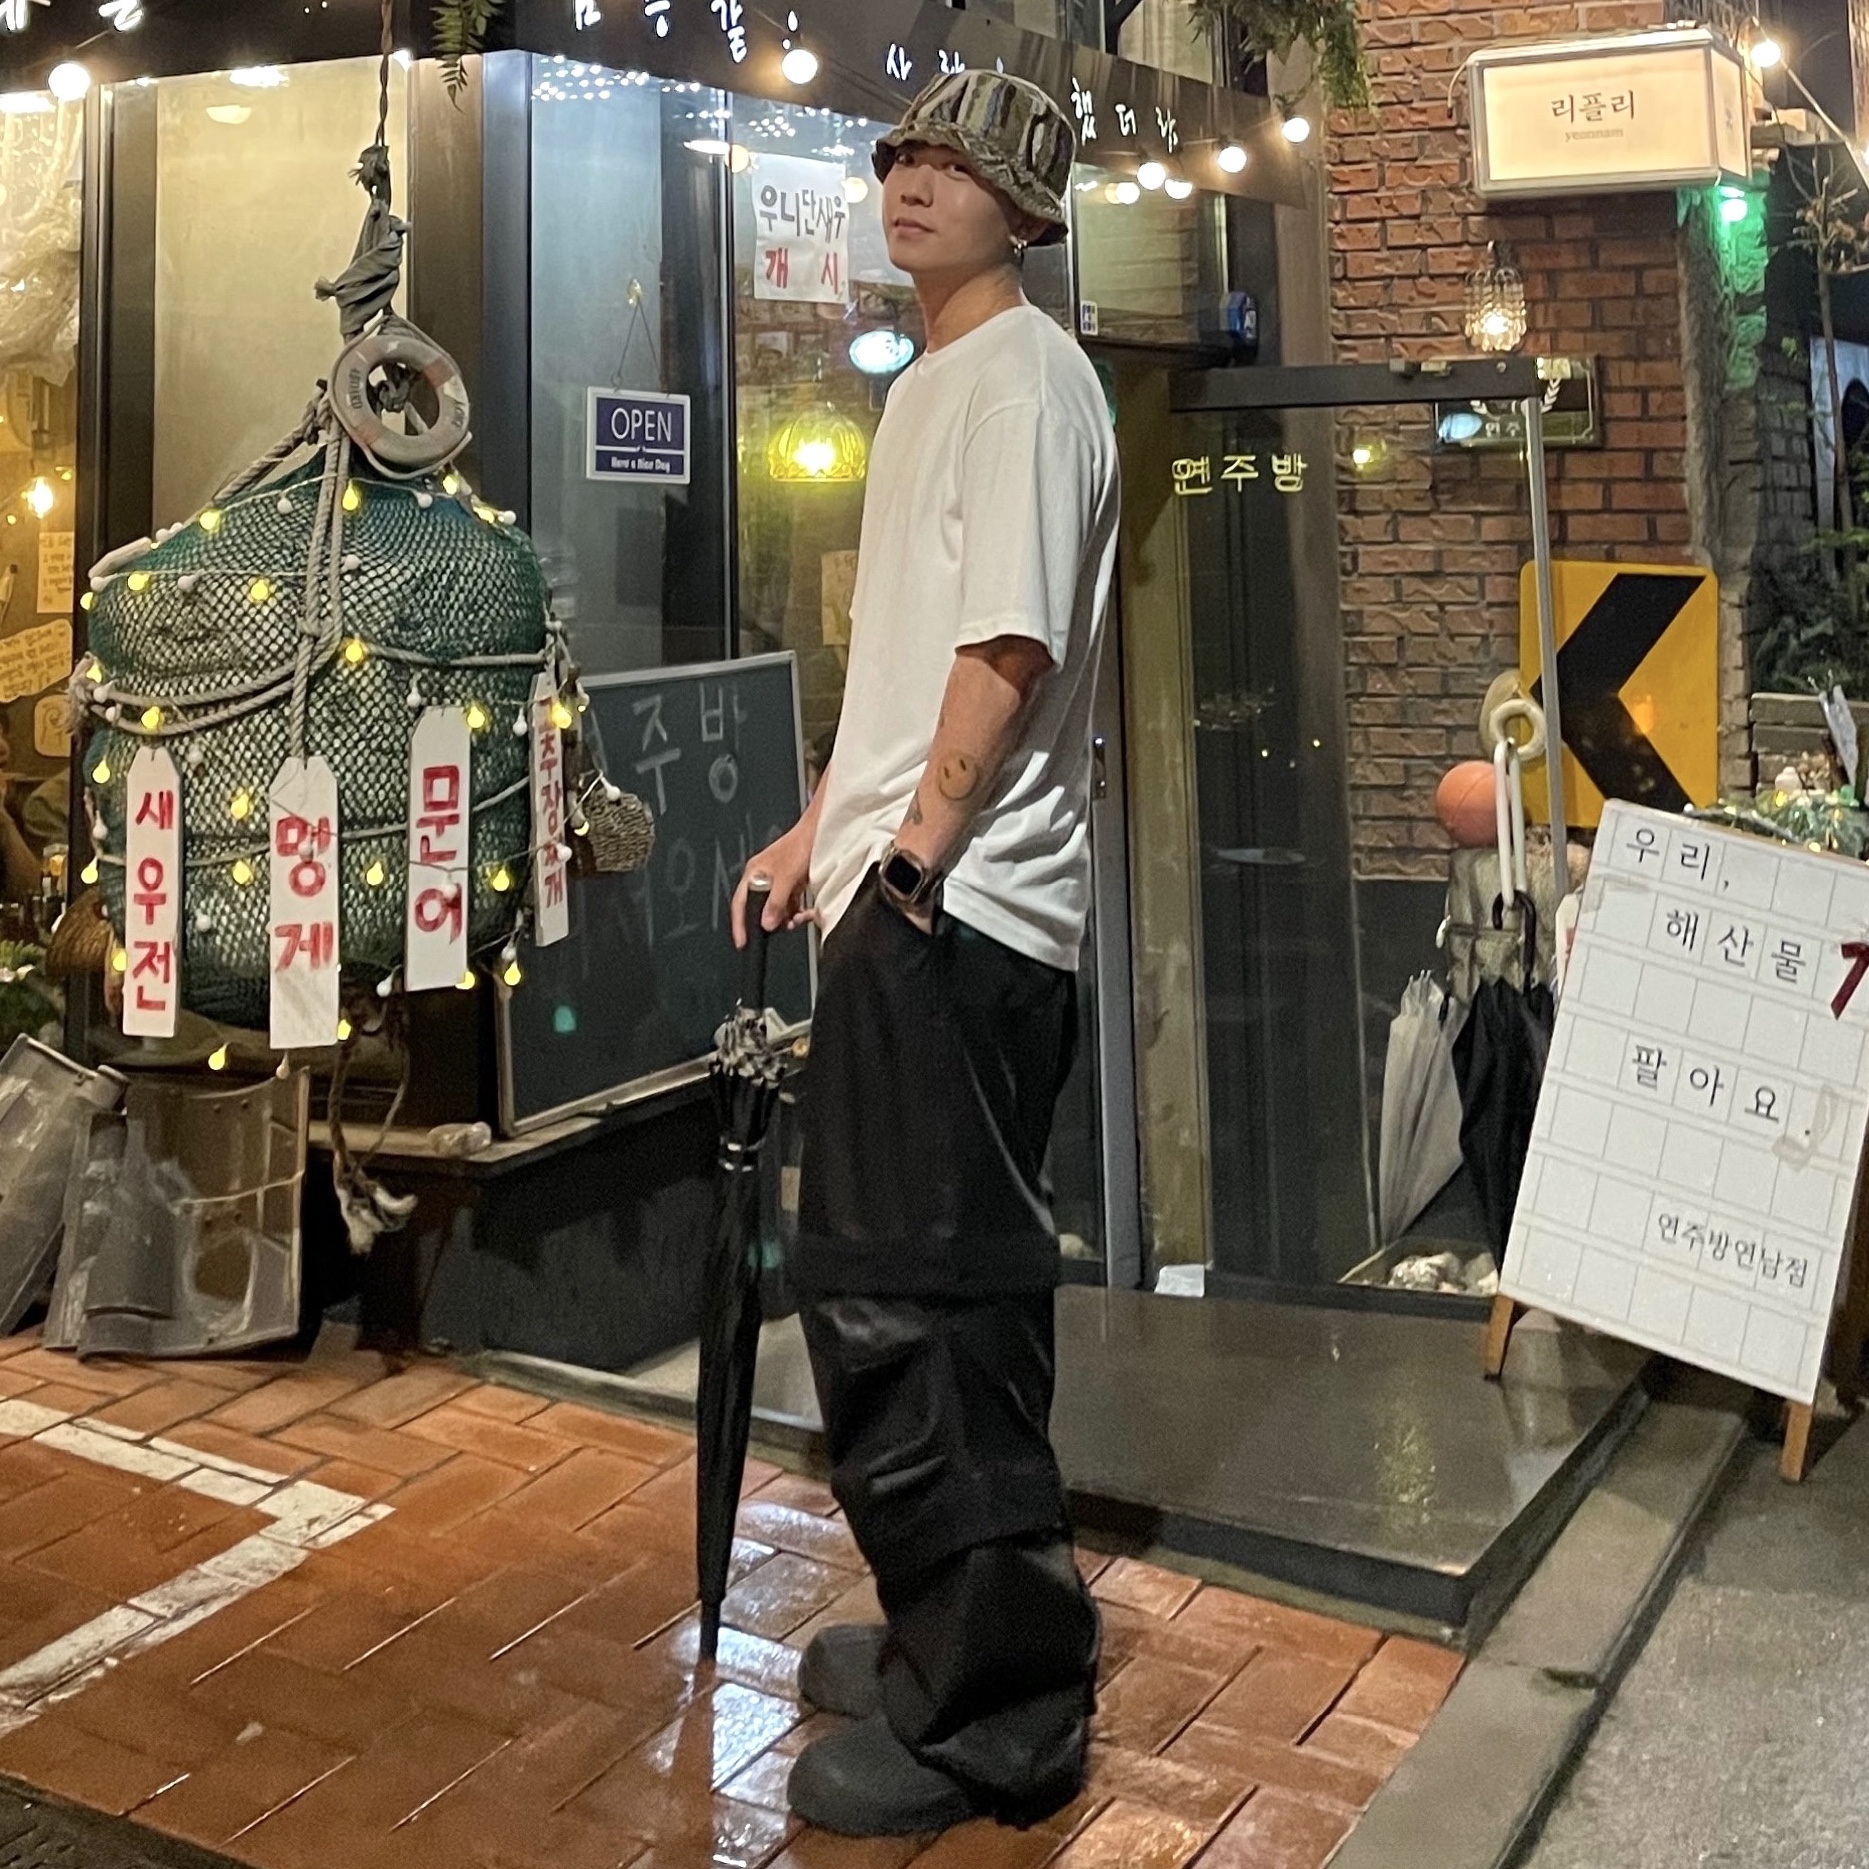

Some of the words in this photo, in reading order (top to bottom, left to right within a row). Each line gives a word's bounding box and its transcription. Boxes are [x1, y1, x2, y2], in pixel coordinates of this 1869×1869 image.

[1551, 90, 1635, 123] 리플리
[611, 407, 672, 442] OPEN
[274, 815, 334, 973] 멍게
[414, 764, 463, 945] 문어
[1626, 827, 1729, 891] 우리,
[132, 789, 174, 1011] 새우전
[1666, 909, 1806, 984] 해산물
[1632, 1045, 1810, 1137] 팔아요.
